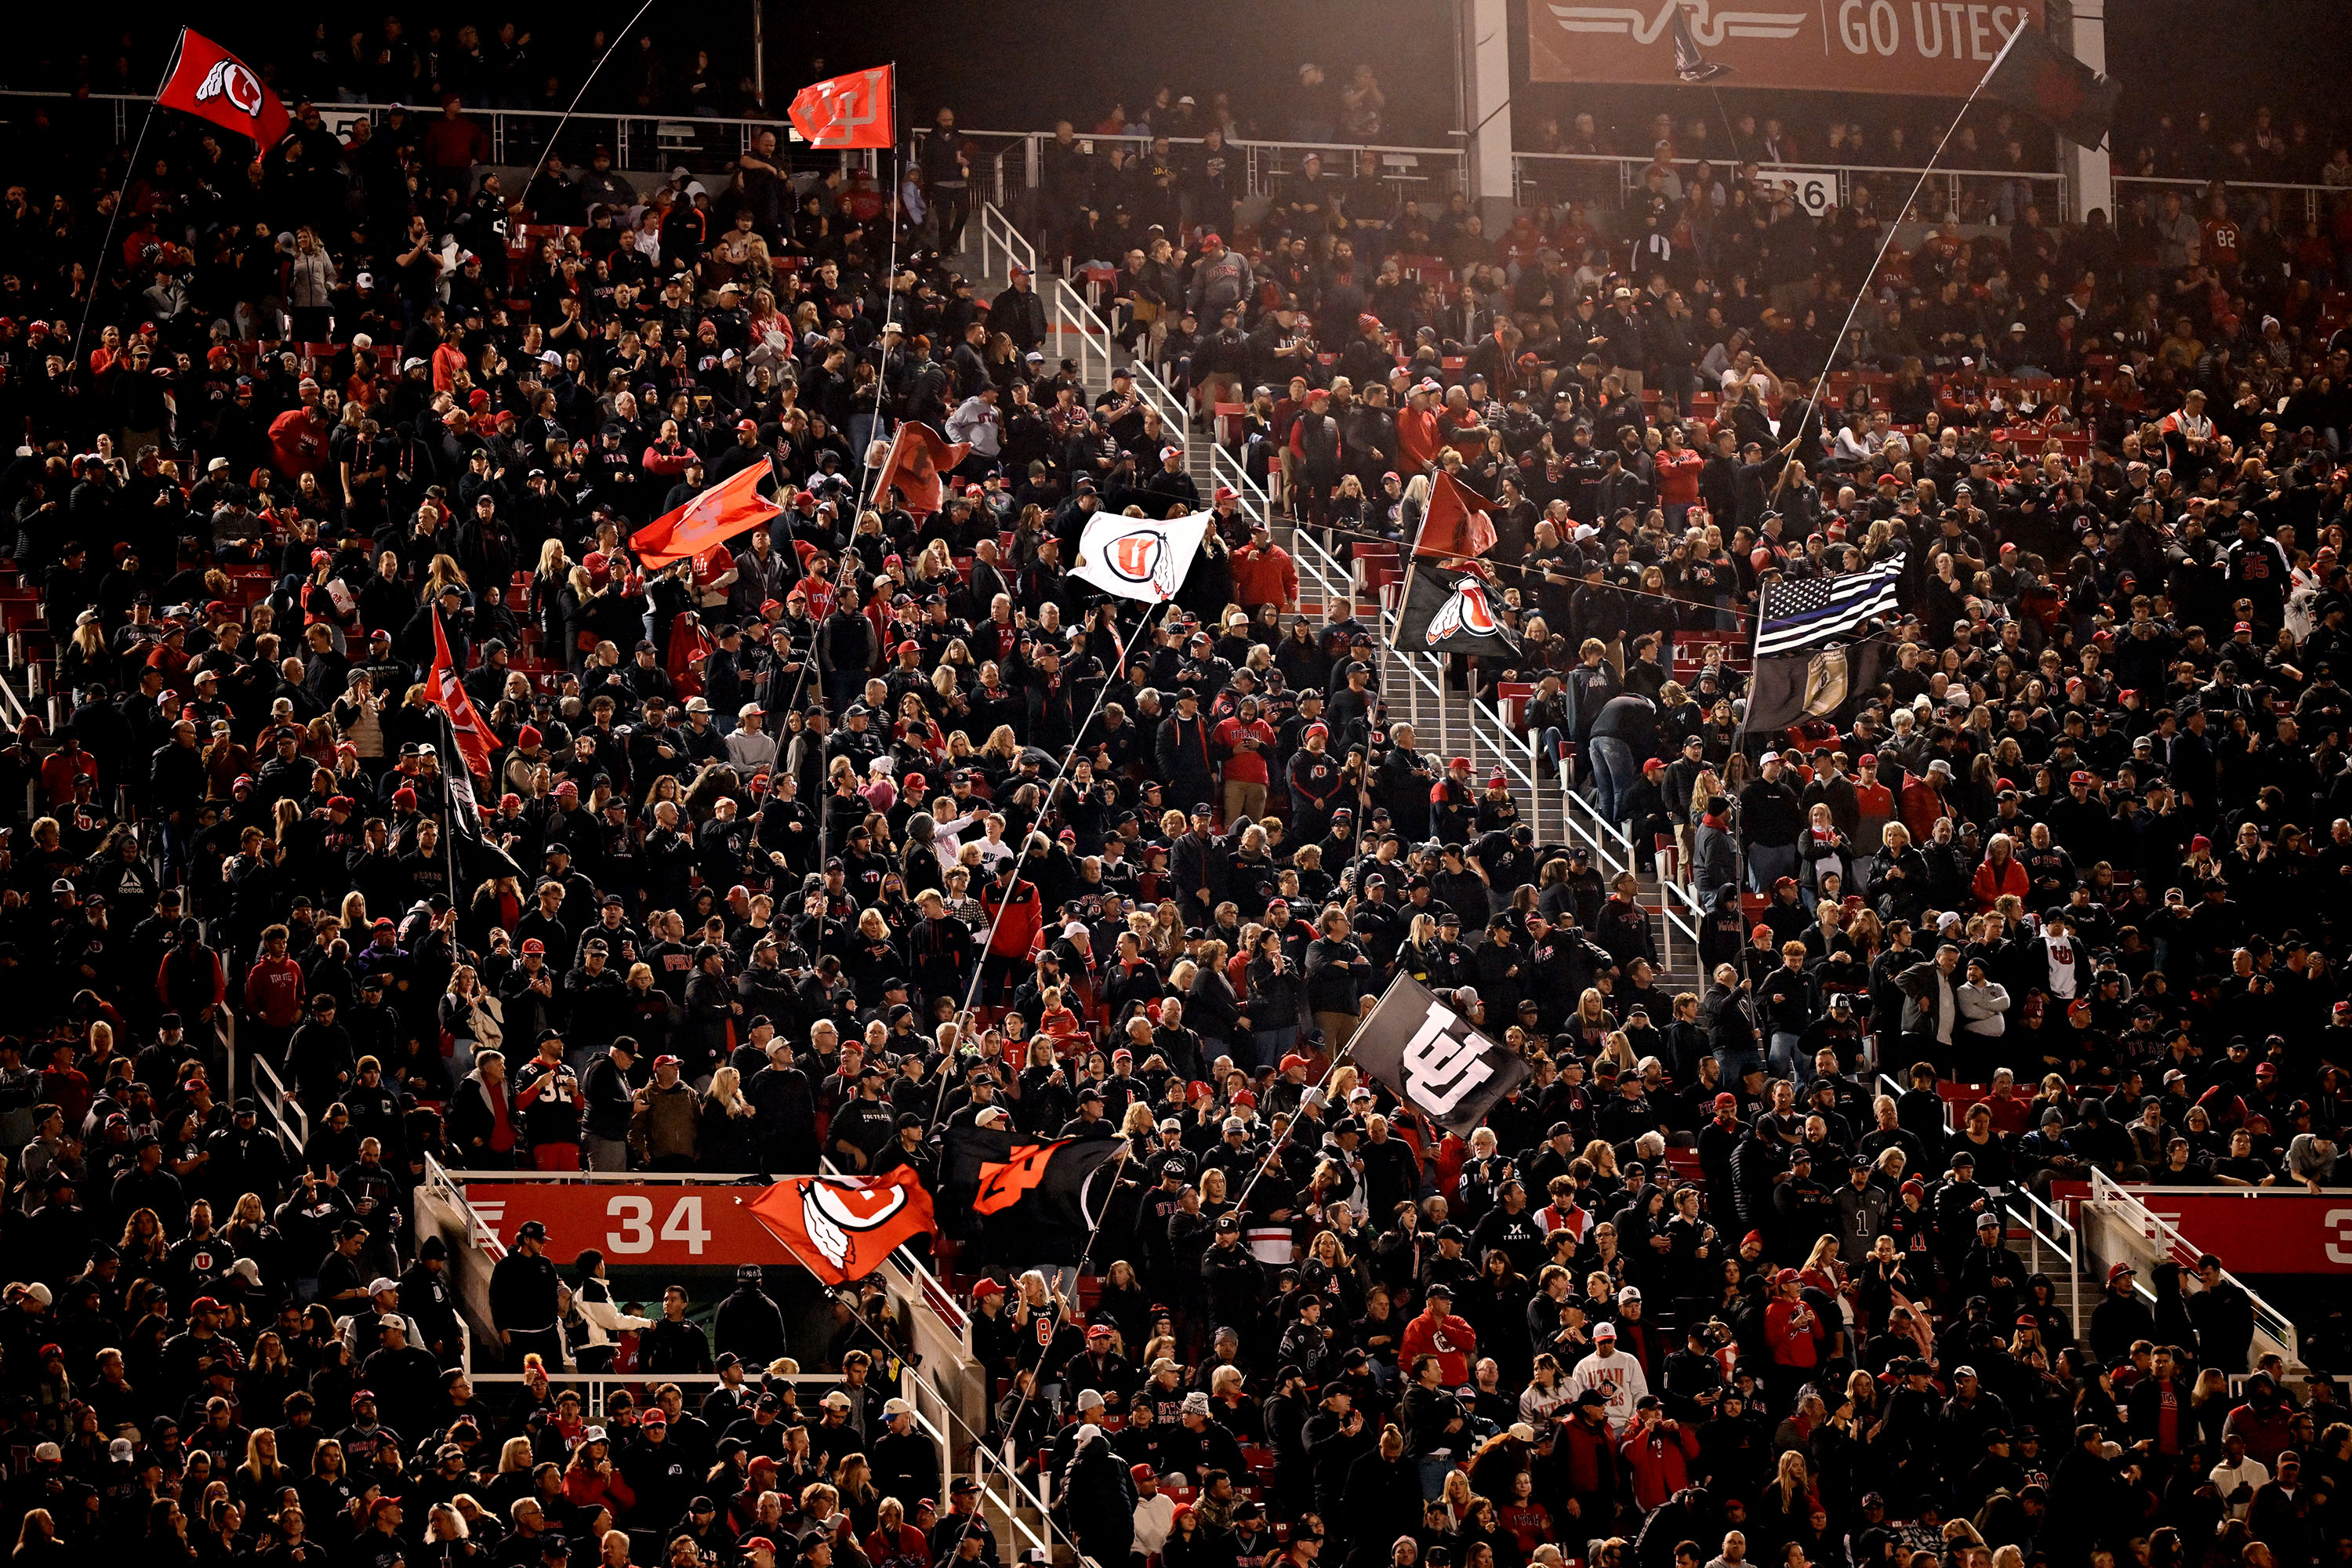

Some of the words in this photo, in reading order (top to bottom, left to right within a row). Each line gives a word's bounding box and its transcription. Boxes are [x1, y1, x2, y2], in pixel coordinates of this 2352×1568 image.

[1839, 0, 1899, 56] GO
[2216, 230, 2236, 248] 82
[1942, 390, 1952, 400] 22
[2241, 555, 2269, 580] 35
[1230, 730, 1261, 740] UTAH
[81, 817, 90, 829] U
[1080, 894, 1103, 906] UTA
[270, 974, 281, 983] UTAH
[282, 972, 292, 982] UTES
[2126, 1041, 2165, 1056] UTAH
[1011, 1054, 1016, 1064] 1
[381, 1099, 392, 1115] C
[1156, 1201, 1180, 1217] UTA
[607, 1196, 712, 1254] 34
[1220, 1218, 1228, 1227] U
[1856, 1210, 1869, 1236] 1
[1910, 1232, 1926, 1251] 11
[2325, 1210, 2352, 1264] 3
[196, 1254, 210, 1268] U
[1036, 1318, 1051, 1346] 8
[1588, 1368, 1624, 1387] UTAH
[1610, 1392, 1624, 1406] ES
[1157, 1414, 1182, 1425] FOOT
[1512, 1513, 1541, 1526] UTAH
